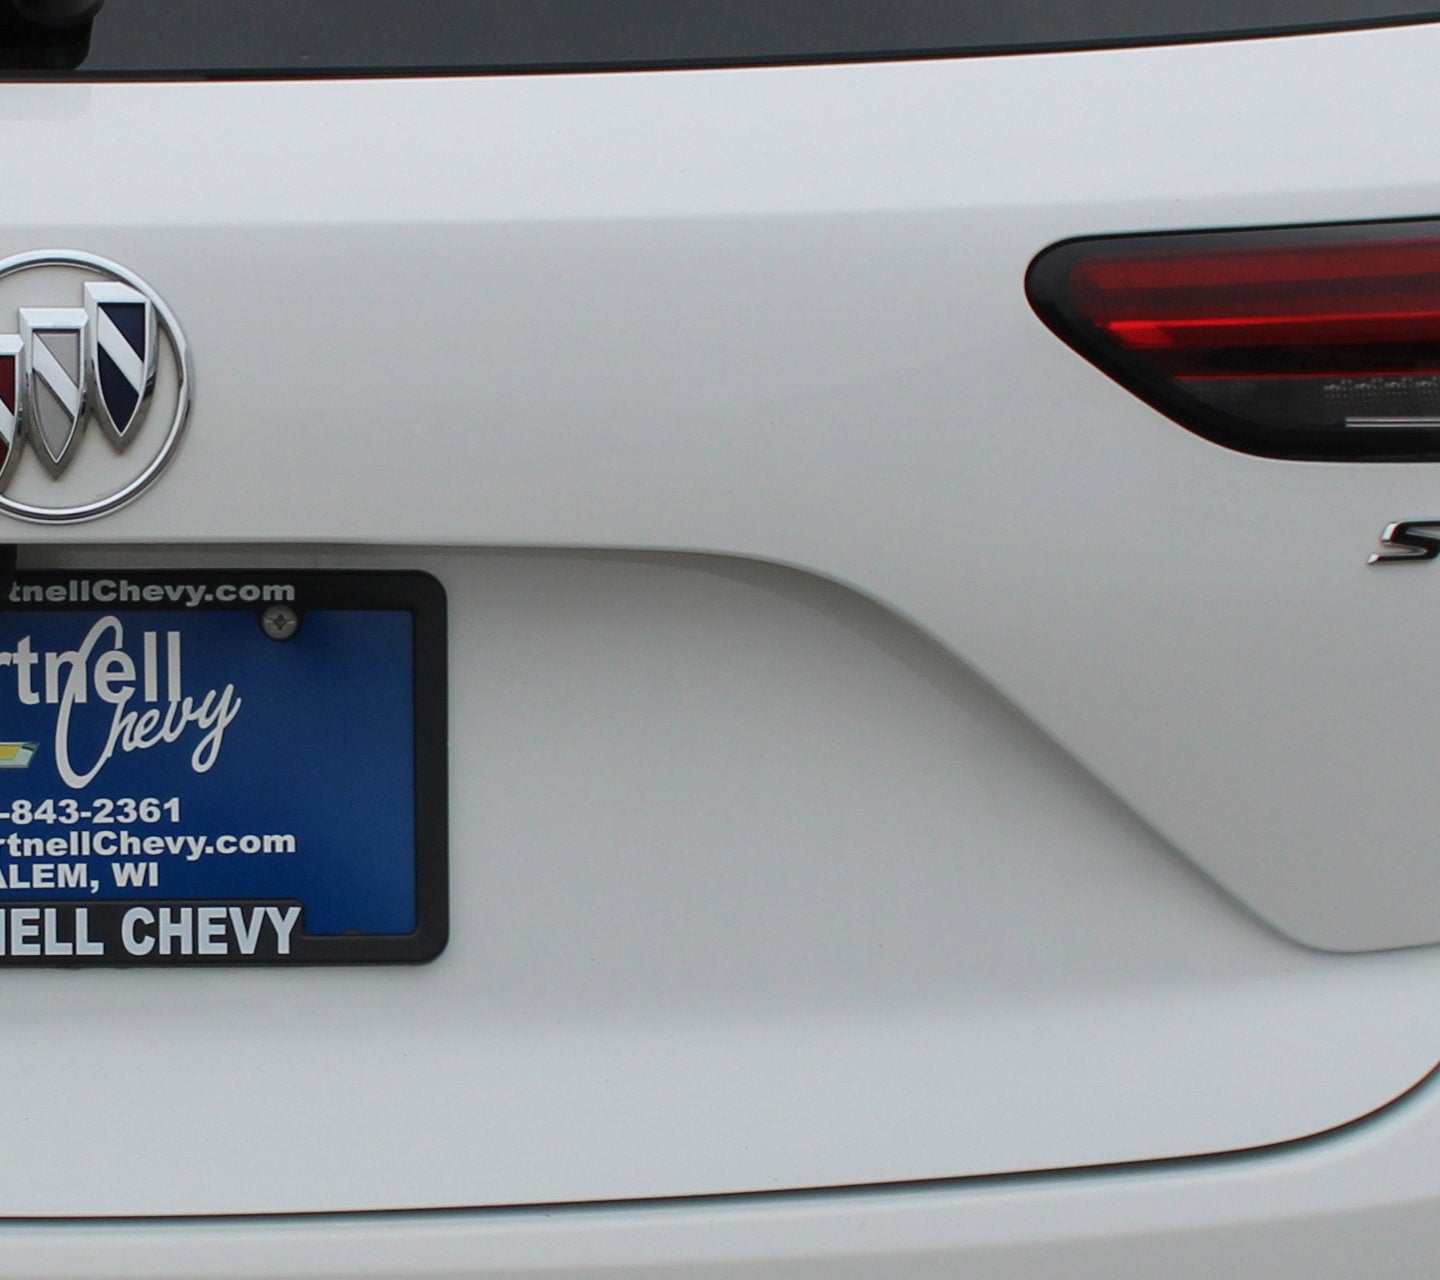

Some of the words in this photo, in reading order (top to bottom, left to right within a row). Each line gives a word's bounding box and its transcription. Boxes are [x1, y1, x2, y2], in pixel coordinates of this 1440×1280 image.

[55, 615, 242, 790] Chevy
[111, 861, 160, 888] WI
[121, 906, 302, 957] CHEVY
